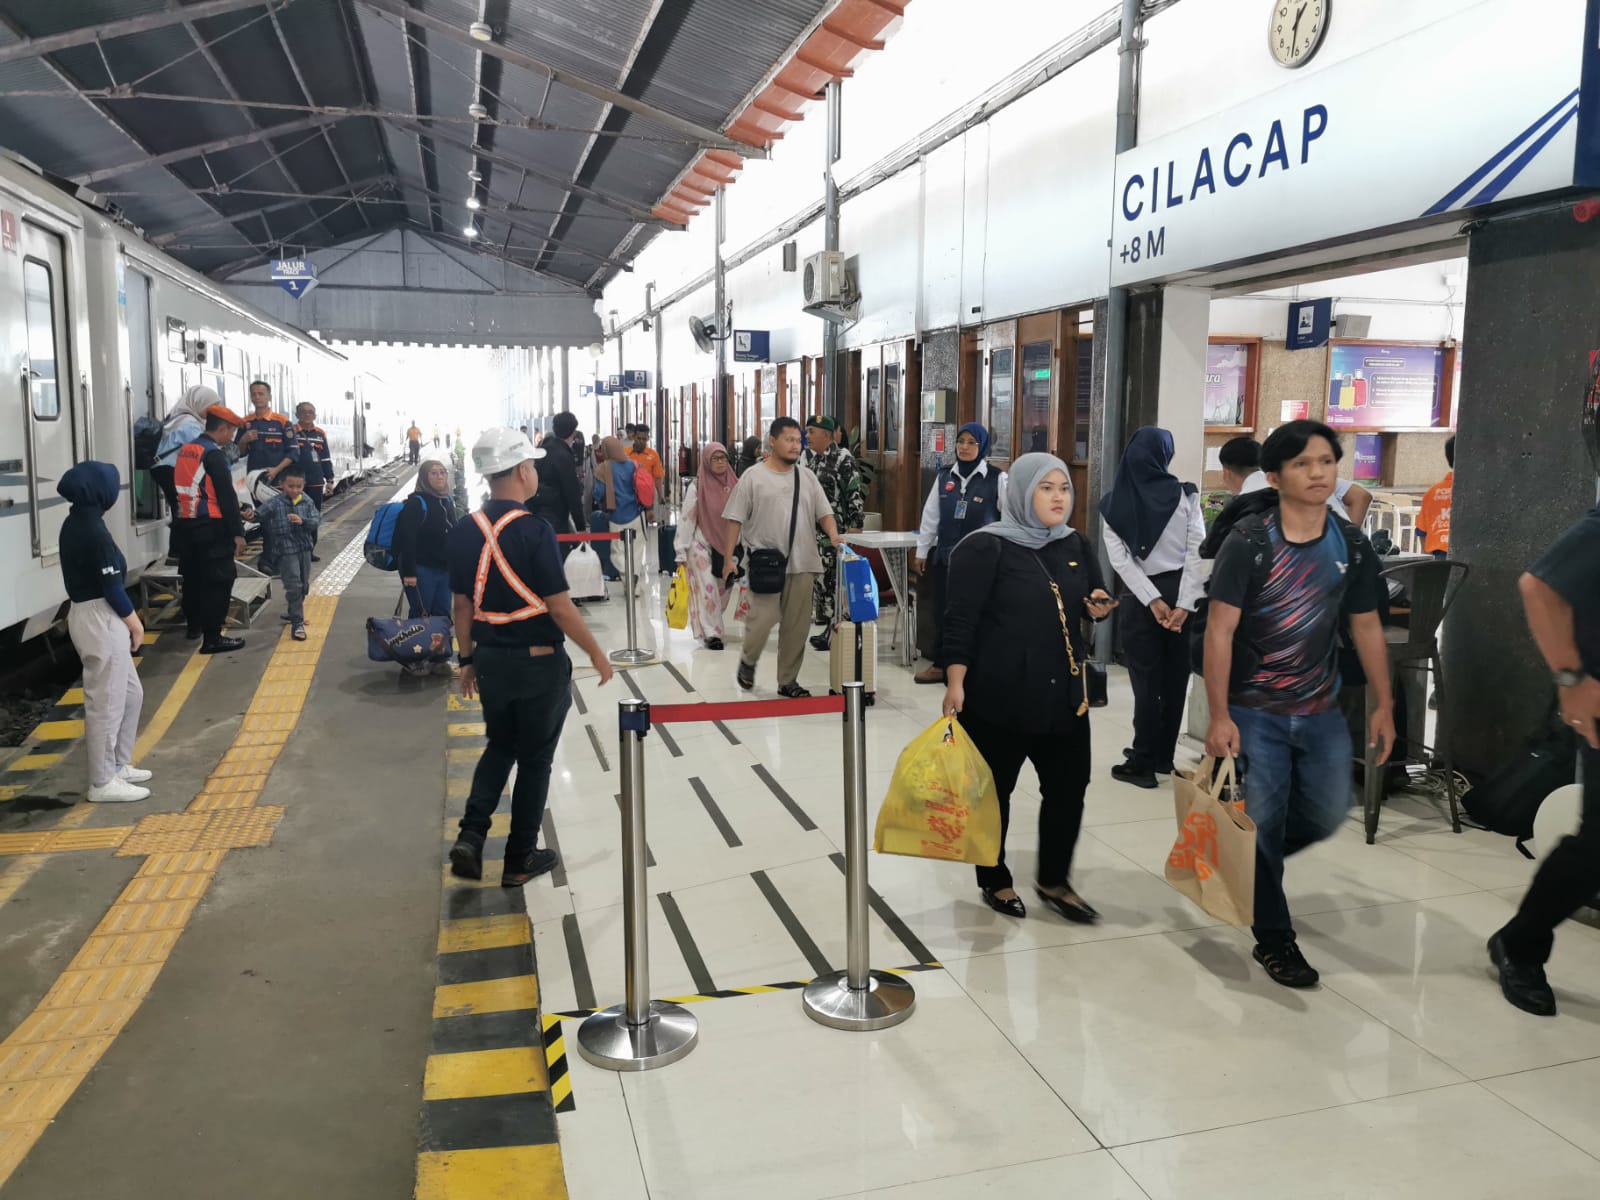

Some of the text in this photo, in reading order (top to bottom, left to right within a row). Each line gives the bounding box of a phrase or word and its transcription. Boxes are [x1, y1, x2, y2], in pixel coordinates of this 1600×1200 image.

[1277, 25, 1282, 35] 9
[1312, 24, 1317, 33] 4
[1280, 38, 1284, 48] 8
[1305, 38, 1310, 48] 5
[1286, 46, 1290, 57] 7
[1295, 47, 1300, 56] 6
[1122, 104, 1328, 221] CILACAP
[1120, 226, 1165, 264] +8 M
[276, 261, 306, 271] JALUR
[289, 281, 299, 290] 1
